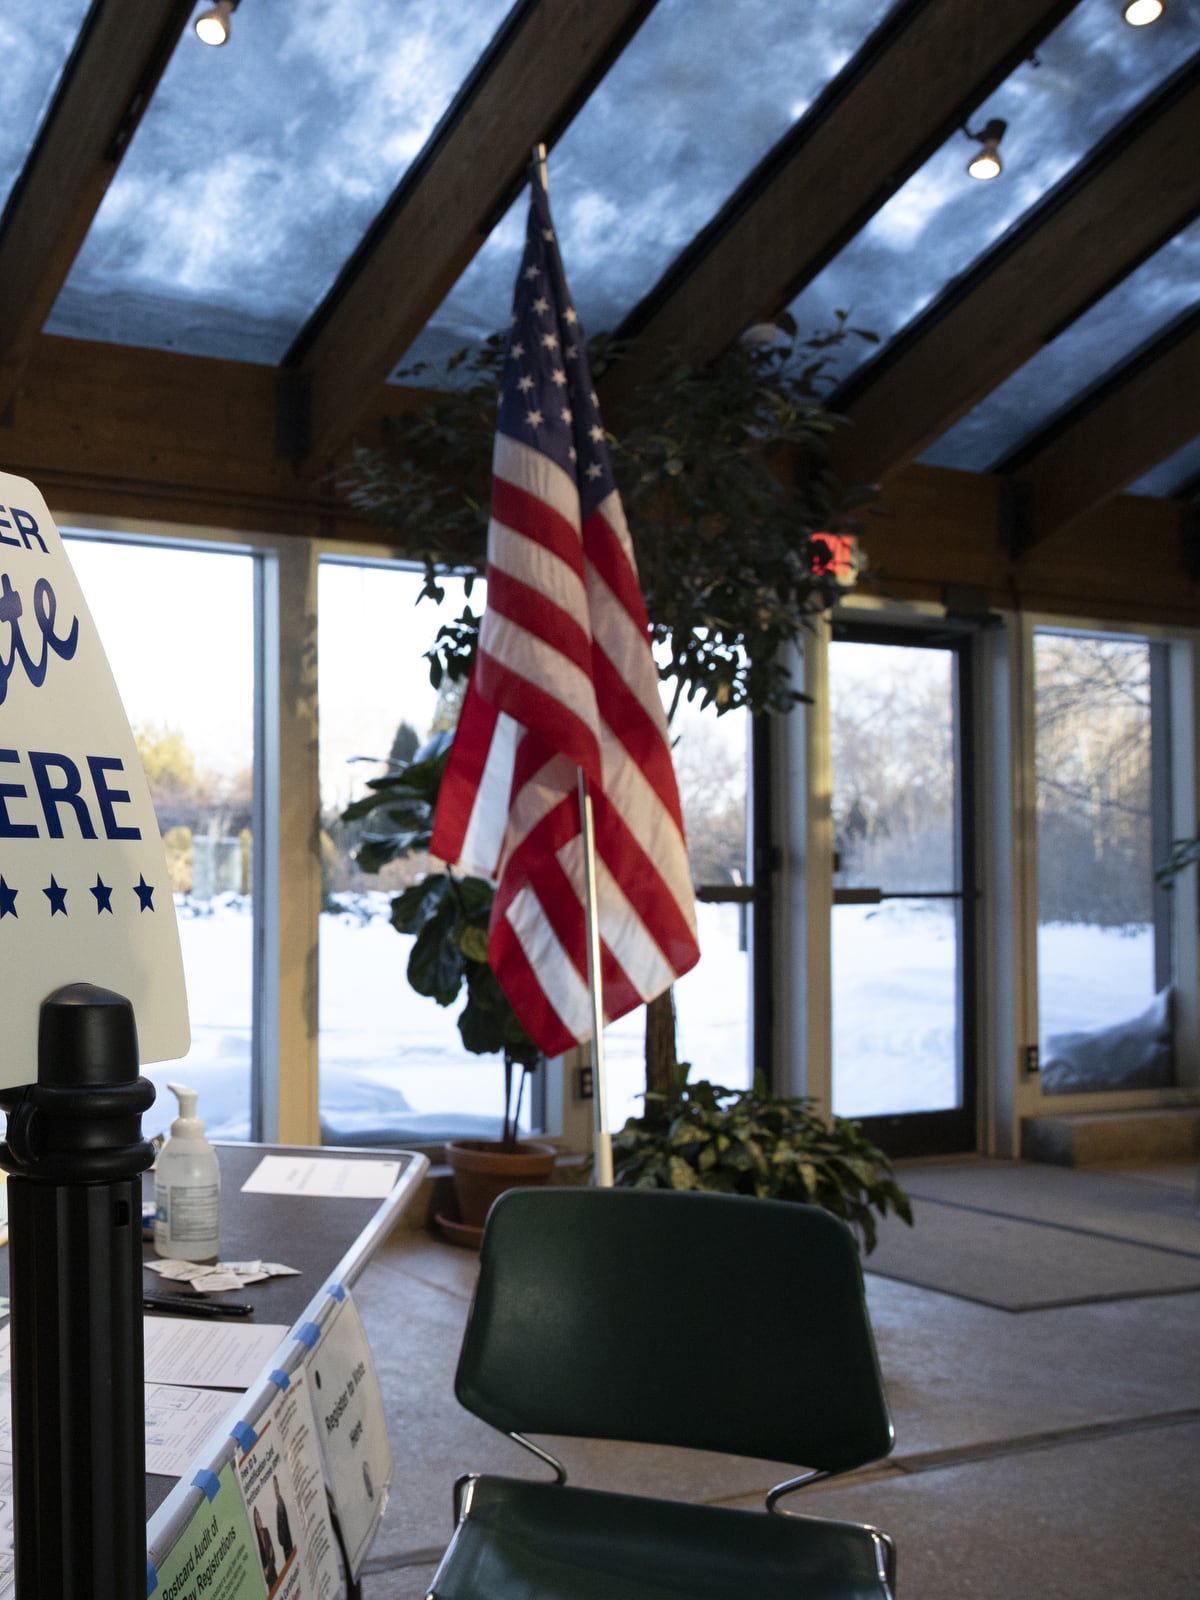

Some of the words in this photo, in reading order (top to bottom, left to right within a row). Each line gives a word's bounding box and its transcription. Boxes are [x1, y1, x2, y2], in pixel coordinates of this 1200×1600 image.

[194, 1528, 212, 1565] Audit
[211, 1514, 219, 1537] of
[196, 1526, 237, 1596] Registrations
